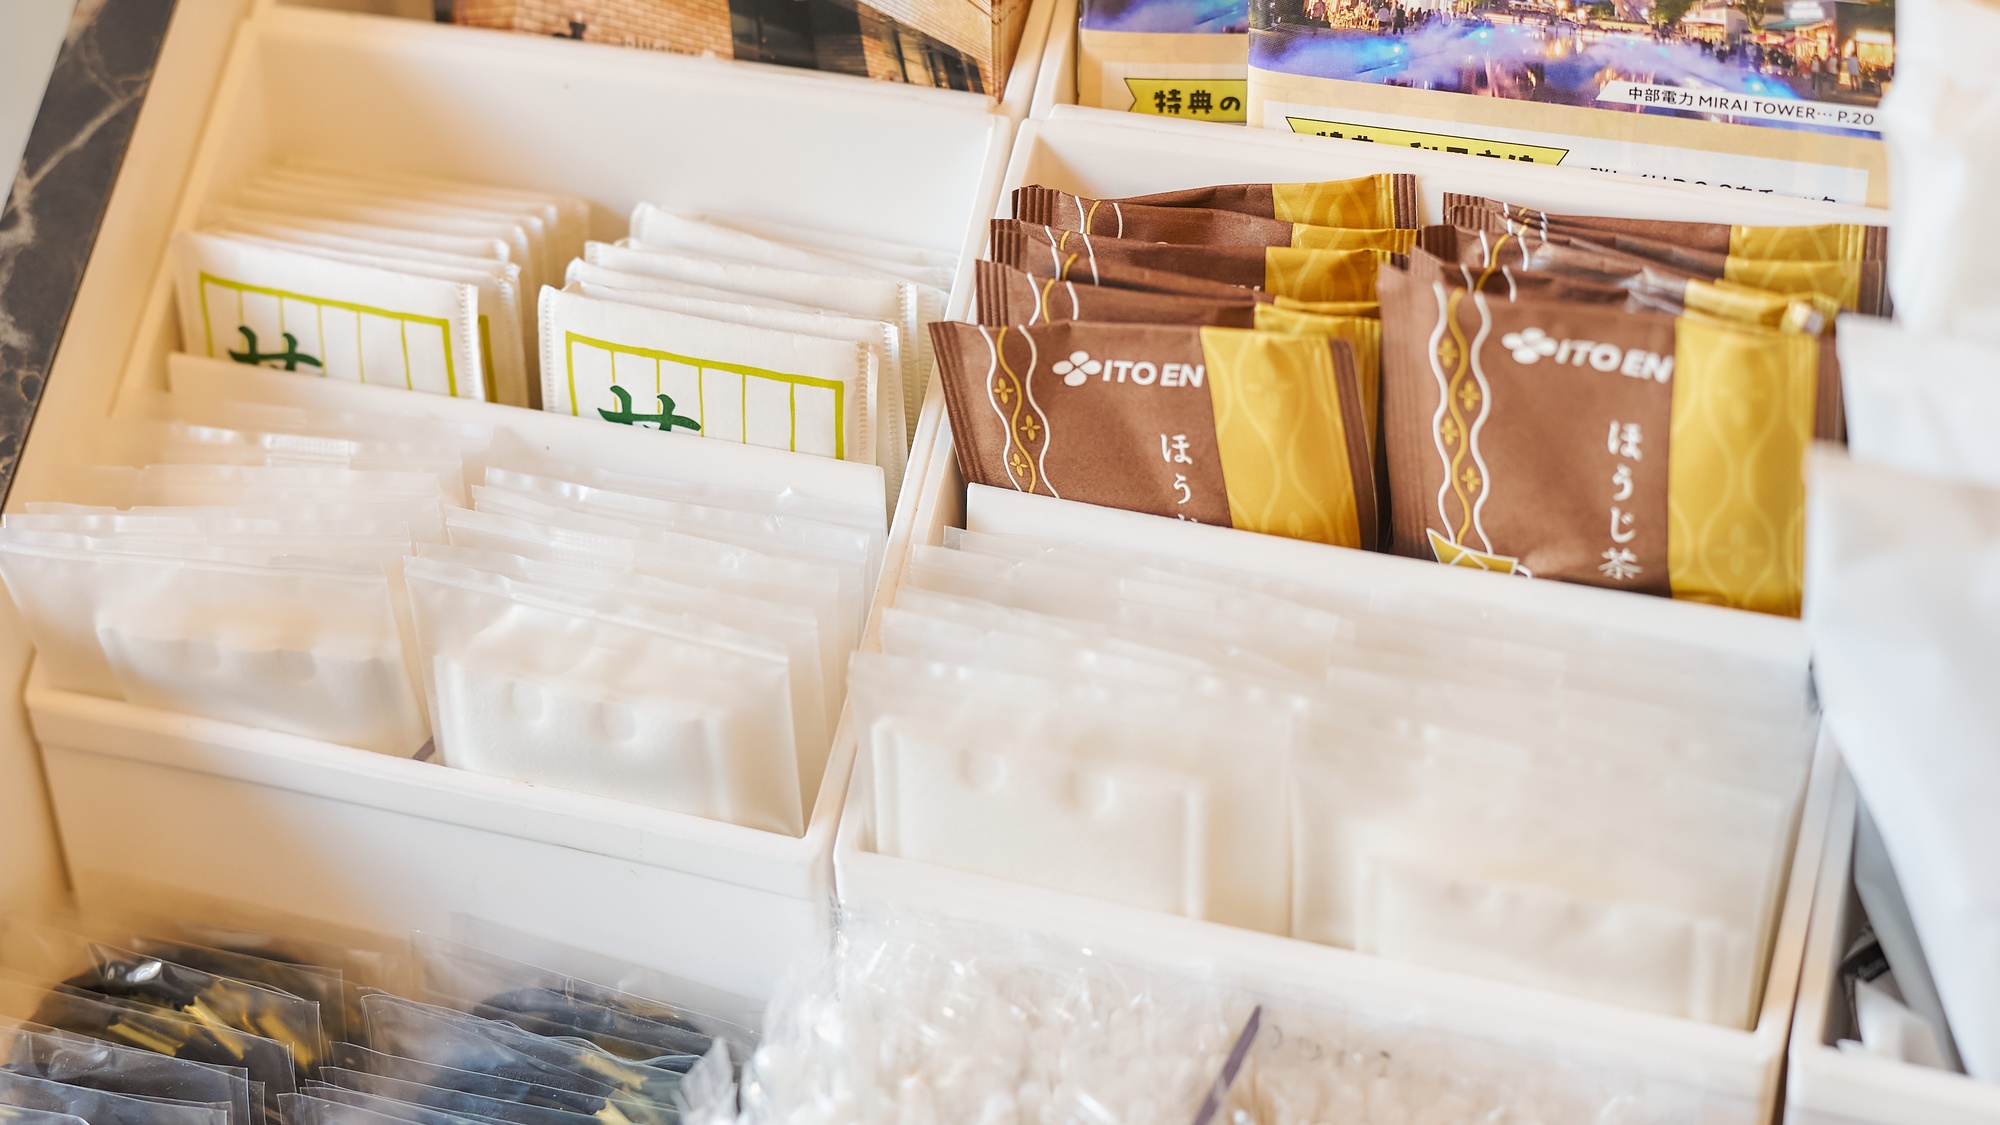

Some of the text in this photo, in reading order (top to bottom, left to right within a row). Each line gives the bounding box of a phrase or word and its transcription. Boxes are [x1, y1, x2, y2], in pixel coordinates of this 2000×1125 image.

[1154, 89, 1241, 114] 特典の
[1628, 86, 1694, 107] 中部電力
[1699, 95, 1748, 112] MIRAI
[1838, 111, 1875, 126] P.20
[1102, 360, 1205, 388] ITO EN
[1555, 340, 1674, 384] ITO EN
[1160, 433, 1198, 523] ほう
[1599, 419, 1644, 581] ほうじ茶
